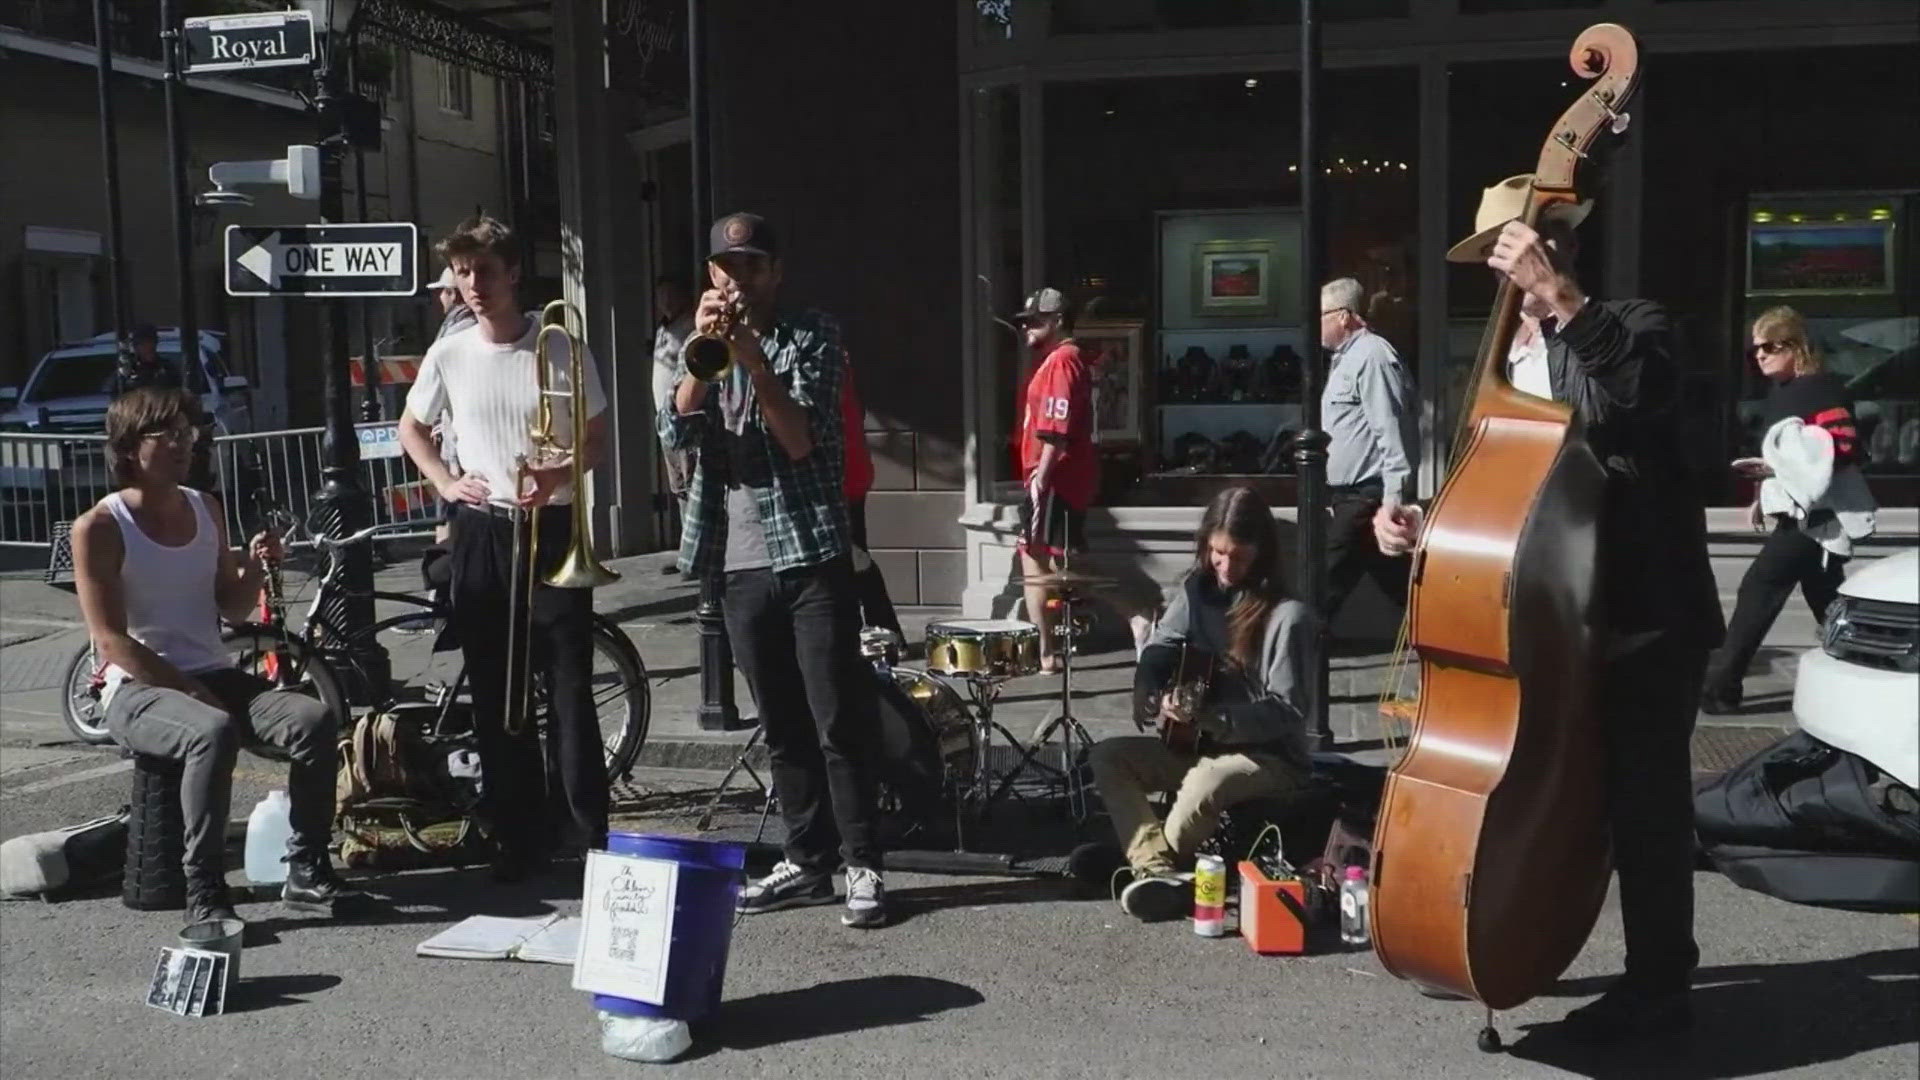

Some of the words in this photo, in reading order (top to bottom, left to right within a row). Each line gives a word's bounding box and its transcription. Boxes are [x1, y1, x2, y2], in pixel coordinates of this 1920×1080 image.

[210, 30, 287, 60] Royal
[285, 247, 334, 273] ONE
[345, 247, 394, 272] WAY
[1045, 396, 1069, 420] 19
